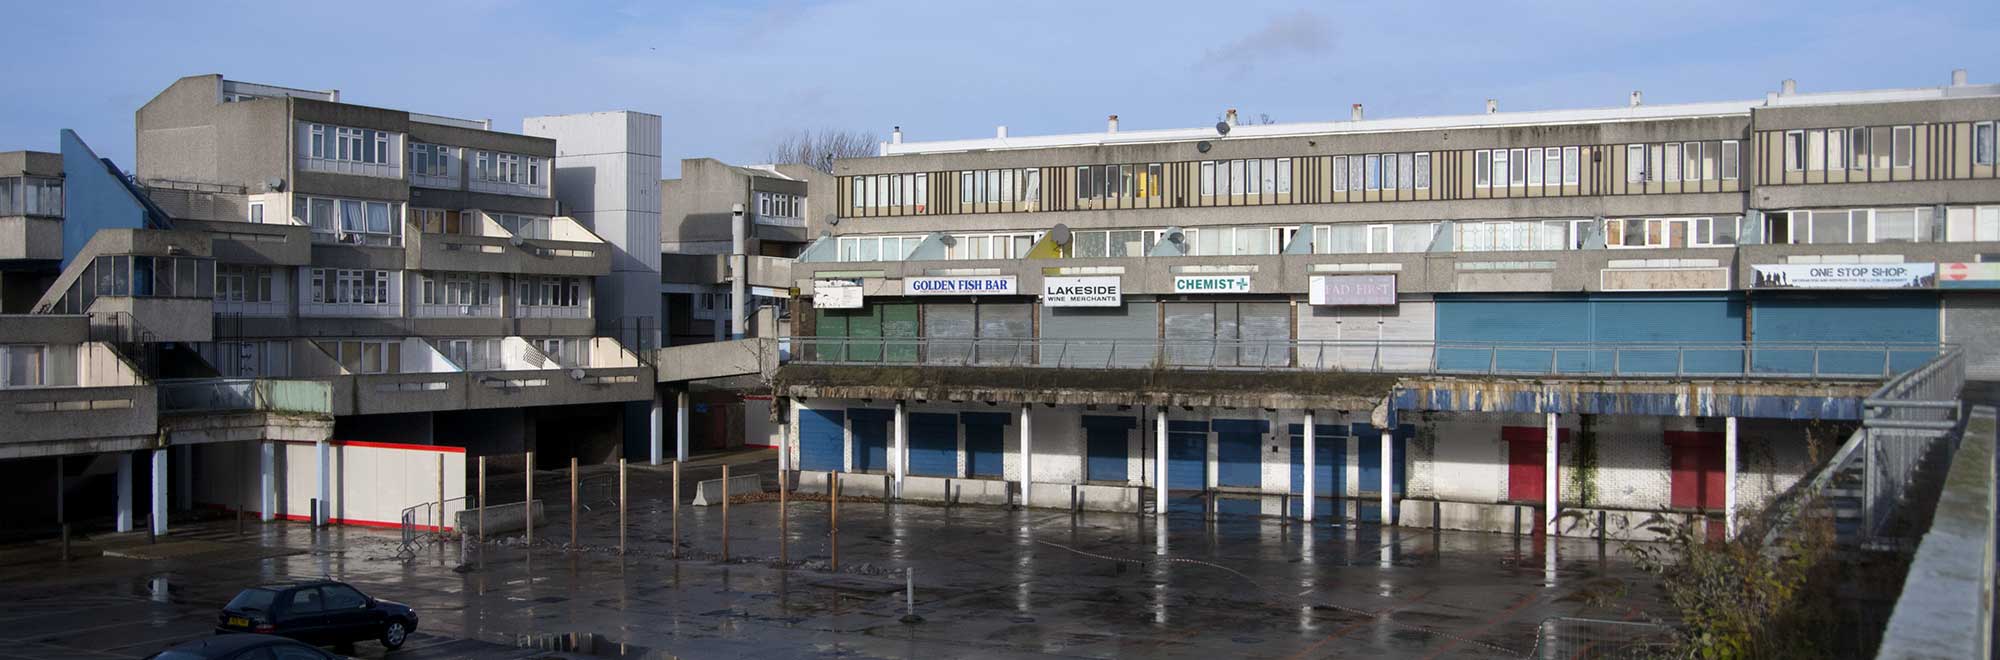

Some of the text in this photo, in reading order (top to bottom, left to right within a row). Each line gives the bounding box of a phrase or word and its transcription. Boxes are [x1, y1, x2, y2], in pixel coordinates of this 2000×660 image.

[1810, 268, 1833, 277] ONE
[1837, 268, 1868, 277] STOP
[913, 280, 1008, 291] GOLDEN FISH BAR
[1177, 279, 1234, 290] CHEMIST
[1047, 286, 1116, 295] LAKESIDE
